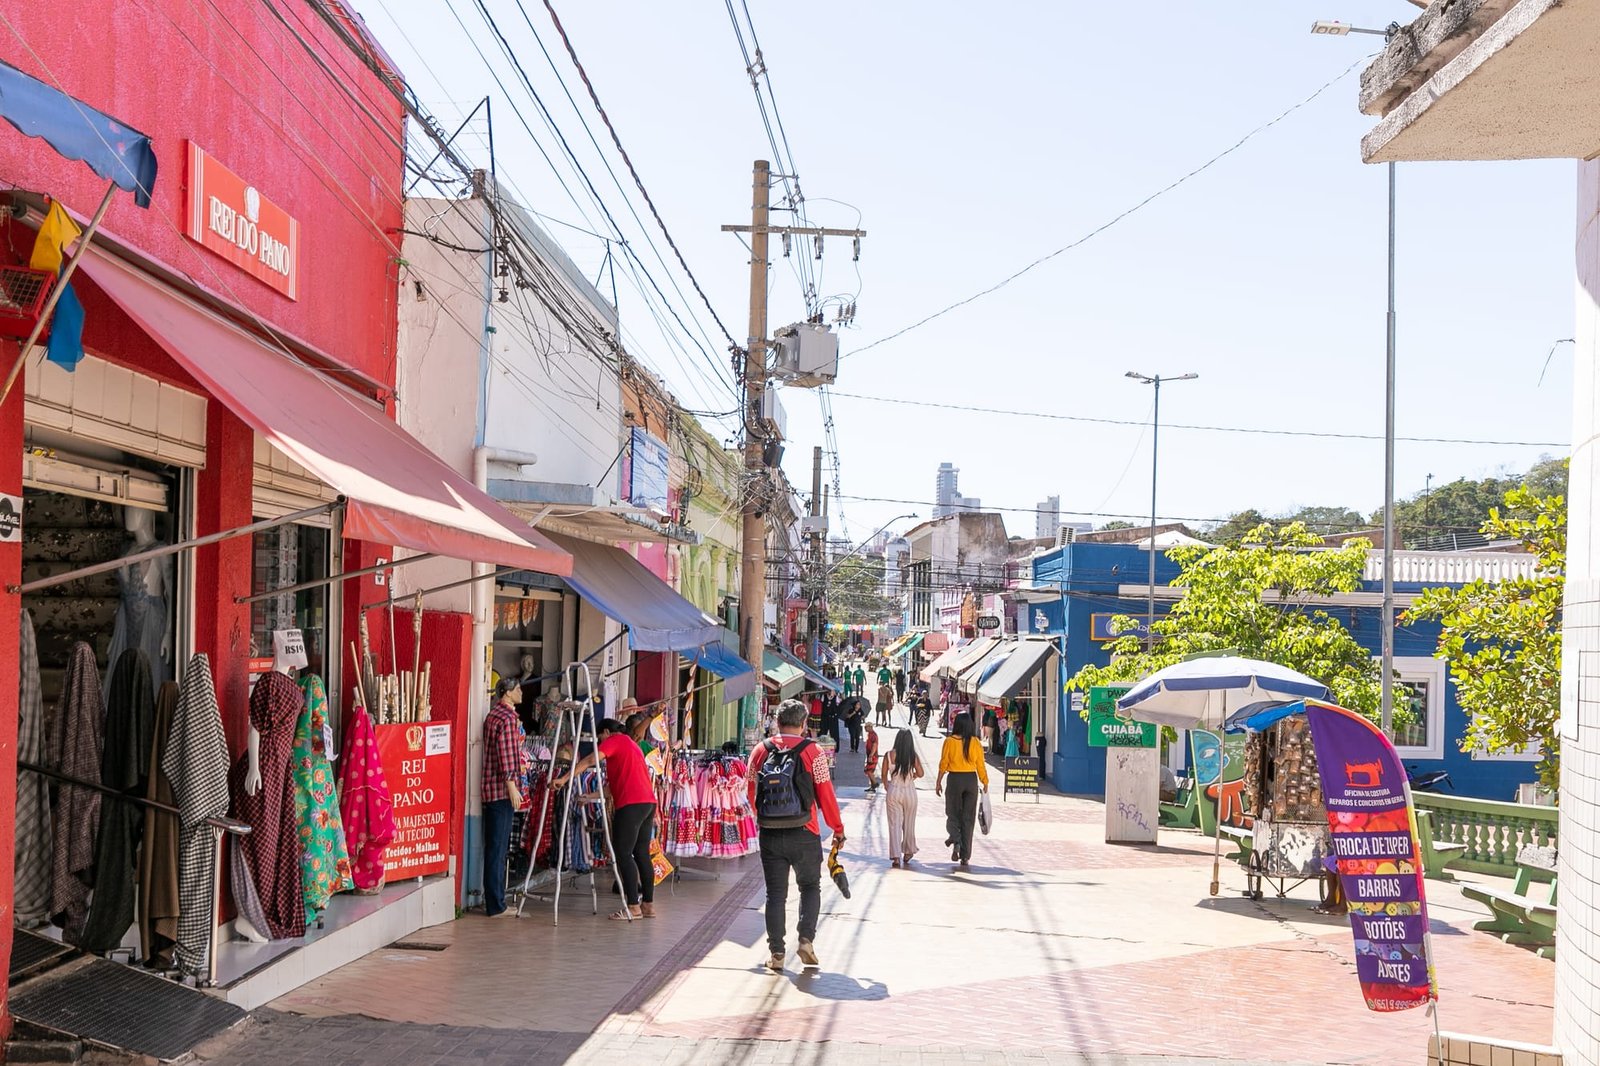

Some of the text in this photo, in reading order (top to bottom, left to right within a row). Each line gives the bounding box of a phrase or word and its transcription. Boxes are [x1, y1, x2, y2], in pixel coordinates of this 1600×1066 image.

[209, 196, 290, 276] REI DO PANO
[1101, 723, 1143, 735] CUIABÁ
[402, 759, 426, 775] REI
[407, 777, 421, 788] DO
[393, 788, 434, 808] PANO
[1329, 798, 1353, 806] REPAROS
[1384, 798, 1391, 806] EM
[1391, 795, 1405, 804] GERAL
[1344, 789, 1364, 797] OFICINA
[1370, 788, 1390, 797] COSTURA
[403, 811, 446, 829] MAJESTADE
[407, 827, 435, 842] TECIDO
[385, 842, 439, 858] Tecidos Malhas
[1334, 837, 1371, 856] TROCA
[1371, 837, 1385, 855] DE
[384, 861, 398, 870] ama
[402, 857, 419, 867] Mesa
[424, 853, 445, 864] Banho
[1358, 878, 1401, 897] BARRAS
[1364, 917, 1406, 940] BOTÕES
